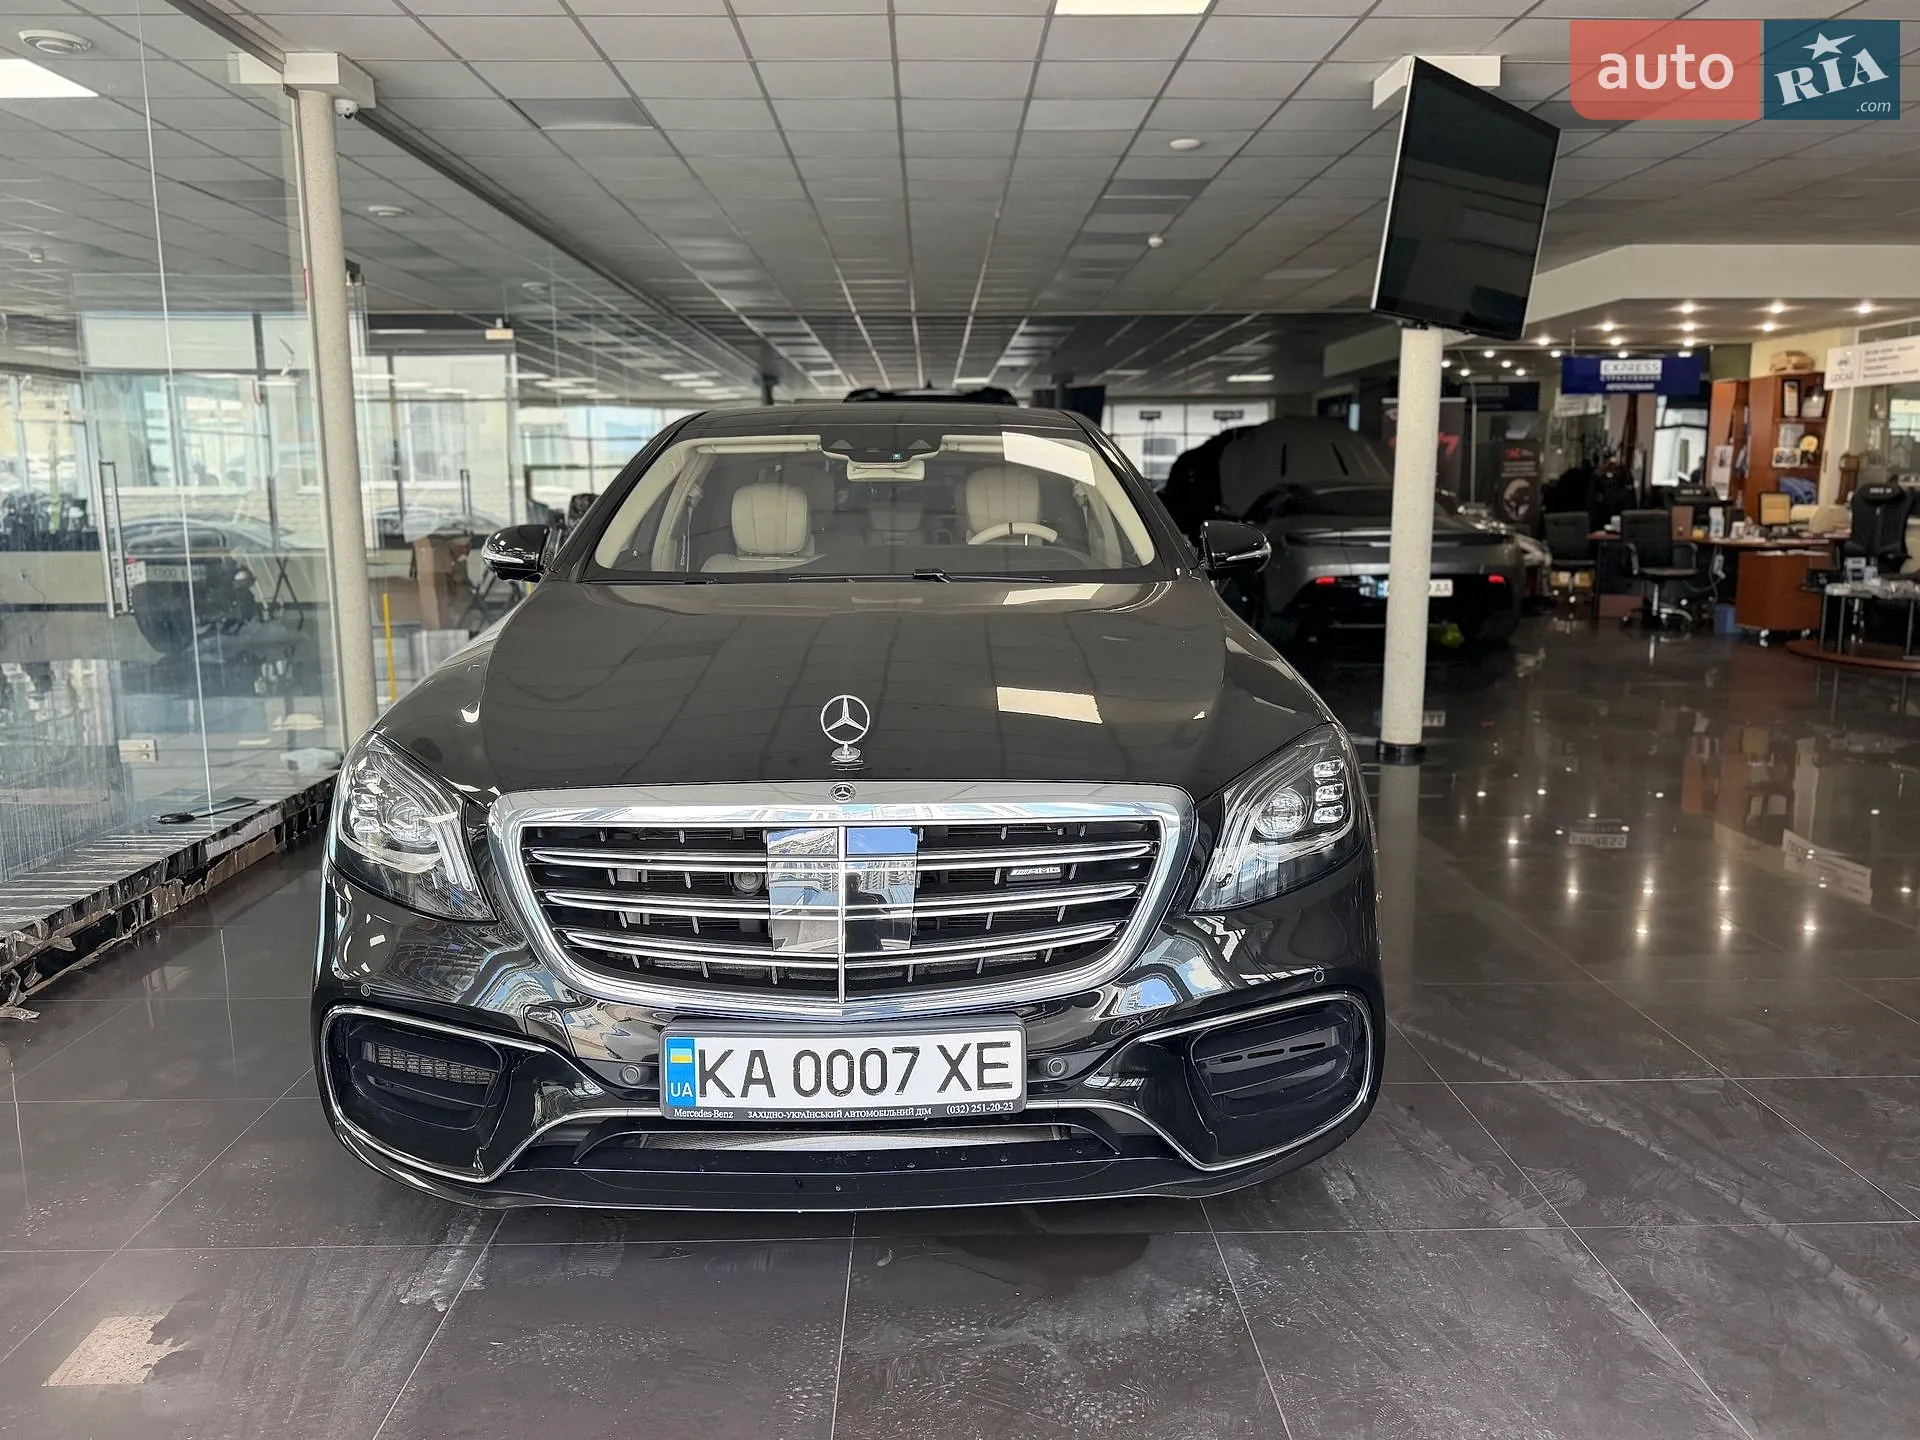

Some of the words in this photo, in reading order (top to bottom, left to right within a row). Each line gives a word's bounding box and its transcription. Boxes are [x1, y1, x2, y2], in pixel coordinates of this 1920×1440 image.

[699, 1049, 776, 1098] KA
[792, 1046, 921, 1098] 0007
[936, 1041, 1014, 1094] XE
[670, 1082, 694, 1098] UA
[674, 1108, 734, 1119] Mercedes-Benz
[747, 1109, 843, 1120] ЗАХІДНО-УКРАЇНСЬКИЙ
[843, 1107, 914, 1118] АВТОМОБІЛЬНИЙ
[915, 1106, 932, 1117] ДІМ
[946, 1103, 970, 1115] (032)
[971, 1102, 1014, 1113] 251-20-23
